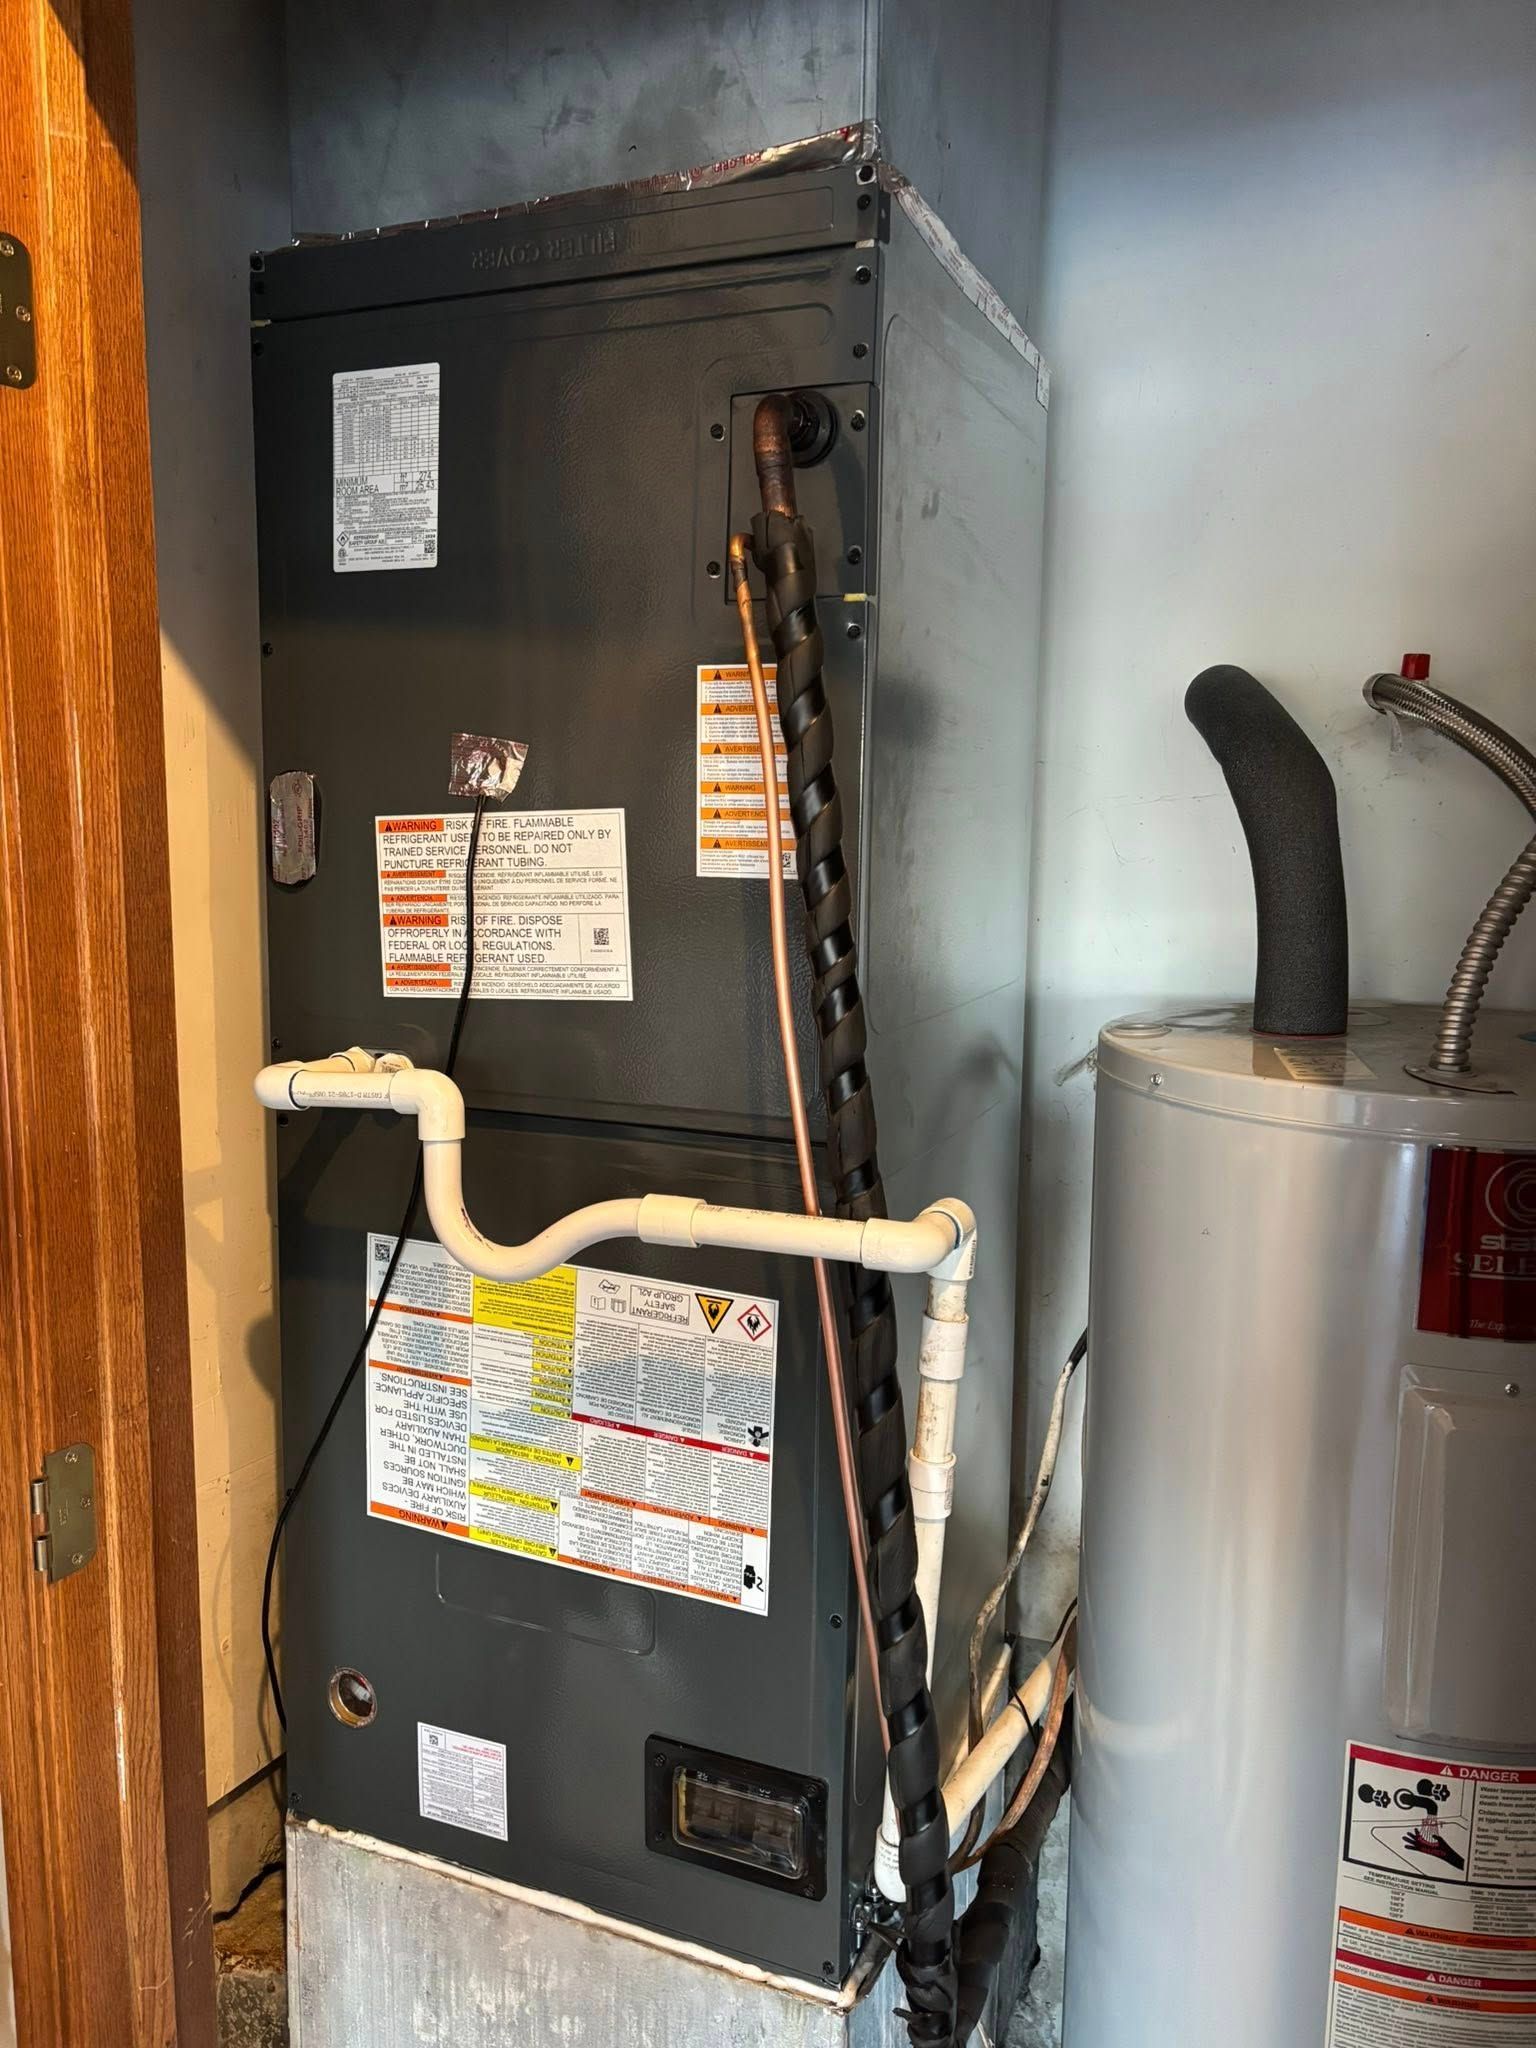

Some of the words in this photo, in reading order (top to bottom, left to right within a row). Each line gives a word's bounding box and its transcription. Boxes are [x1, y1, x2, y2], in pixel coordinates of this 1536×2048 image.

[546, 231, 615, 261] FILTER
[472, 243, 539, 270] COVER
[336, 475, 368, 486] MINIMUM
[336, 487, 358, 496] ROOM
[360, 484, 380, 494] AREA
[392, 820, 437, 831] WARNING
[446, 820, 468, 830] RISK
[486, 818, 510, 828] FIRE.
[514, 816, 574, 828] FLAMMABLE
[383, 834, 448, 844] REFRIGERANT
[450, 832, 473, 842] USE
[482, 832, 496, 842] TO
[498, 832, 512, 841] BE
[514, 830, 564, 840] REPAIRED
[567, 829, 595, 840] ONLY
[598, 829, 612, 839] BY
[384, 847, 423, 856] TRAINED
[426, 846, 466, 856] SERVICE
[472, 844, 532, 855] ERSONNEL.
[534, 844, 549, 854] DO
[552, 844, 573, 853] NOT
[384, 859, 434, 869] PUNCTURE
[507, 857, 548, 867] TUBING.
[397, 916, 442, 925] WARNING
[451, 916, 467, 925] RIS
[476, 916, 488, 925] OF
[492, 916, 516, 926] FIRE.
[518, 916, 563, 926] DISPOSE
[388, 928, 450, 938] OFPROPERLY
[452, 929, 462, 938] IN
[536, 928, 562, 938] WITH
[388, 941, 430, 950] FEDERAL
[432, 941, 446, 950] OR
[449, 941, 480, 950] LOCL
[482, 941, 556, 950] REGULATIONS.
[390, 953, 444, 962] FLAMMABLE
[518, 954, 548, 963] USED.
[638, 1288, 652, 1297] A2L
[654, 1292, 684, 1302] GROUP
[644, 1299, 676, 1311] SAFETY
[631, 1306, 688, 1323] REFRIGERANT
[379, 1372, 447, 1394] INSTRUCTIONS.
[373, 1382, 424, 1400] APPLIANCE.
[450, 1388, 468, 1398] SEE
[403, 1400, 421, 1411] THE
[426, 1394, 468, 1408] SPECIFIC
[375, 1404, 393, 1416] FOR
[395, 1409, 426, 1423] LISTED
[424, 1405, 446, 1416] WITH
[448, 1410, 467, 1420] USE
[395, 1420, 440, 1438] AUXILIARY
[428, 1416, 467, 1432] DEVICES
[590, 1418, 614, 1428] PELIGRO
[380, 1428, 410, 1442] OTHER
[442, 1432, 466, 1444] THAN
[653, 1432, 678, 1442] DANGER
[388, 1440, 405, 1452] THE
[408, 1446, 416, 1454] IN
[412, 1434, 466, 1455] DUCTWORK,
[418, 1448, 466, 1466] INSTALLED
[721, 1446, 748, 1456] DANGER
[404, 1455, 416, 1465] BE
[418, 1459, 436, 1470] NOT
[384, 1460, 425, 1478] SOURCES
[438, 1463, 466, 1478] SHALL
[402, 1476, 414, 1486] BE
[416, 1480, 434, 1492] MAY
[428, 1472, 466, 1488] IGNITION
[382, 1482, 420, 1499] DEVICES
[436, 1486, 466, 1500] WHICH
[410, 1500, 429, 1512] FIRE
[422, 1493, 466, 1510] AUXILIARY
[432, 1508, 444, 1516] OF
[446, 1510, 466, 1522] RISK
[398, 1510, 440, 1528] WARNING
[522, 1546, 547, 1558] CAUTION
[1460, 1768, 1520, 1782] DANGER
[1368, 1870, 1412, 1884] TEMPERATURE
[1412, 1880, 1436, 1890] SETTING
[1376, 1877, 1414, 1891] INSTRUCTION
[1414, 1887, 1440, 1896] MANUAL
[1416, 1929, 1458, 1942] WARNING
[1438, 1974, 1482, 1988] DANGER
